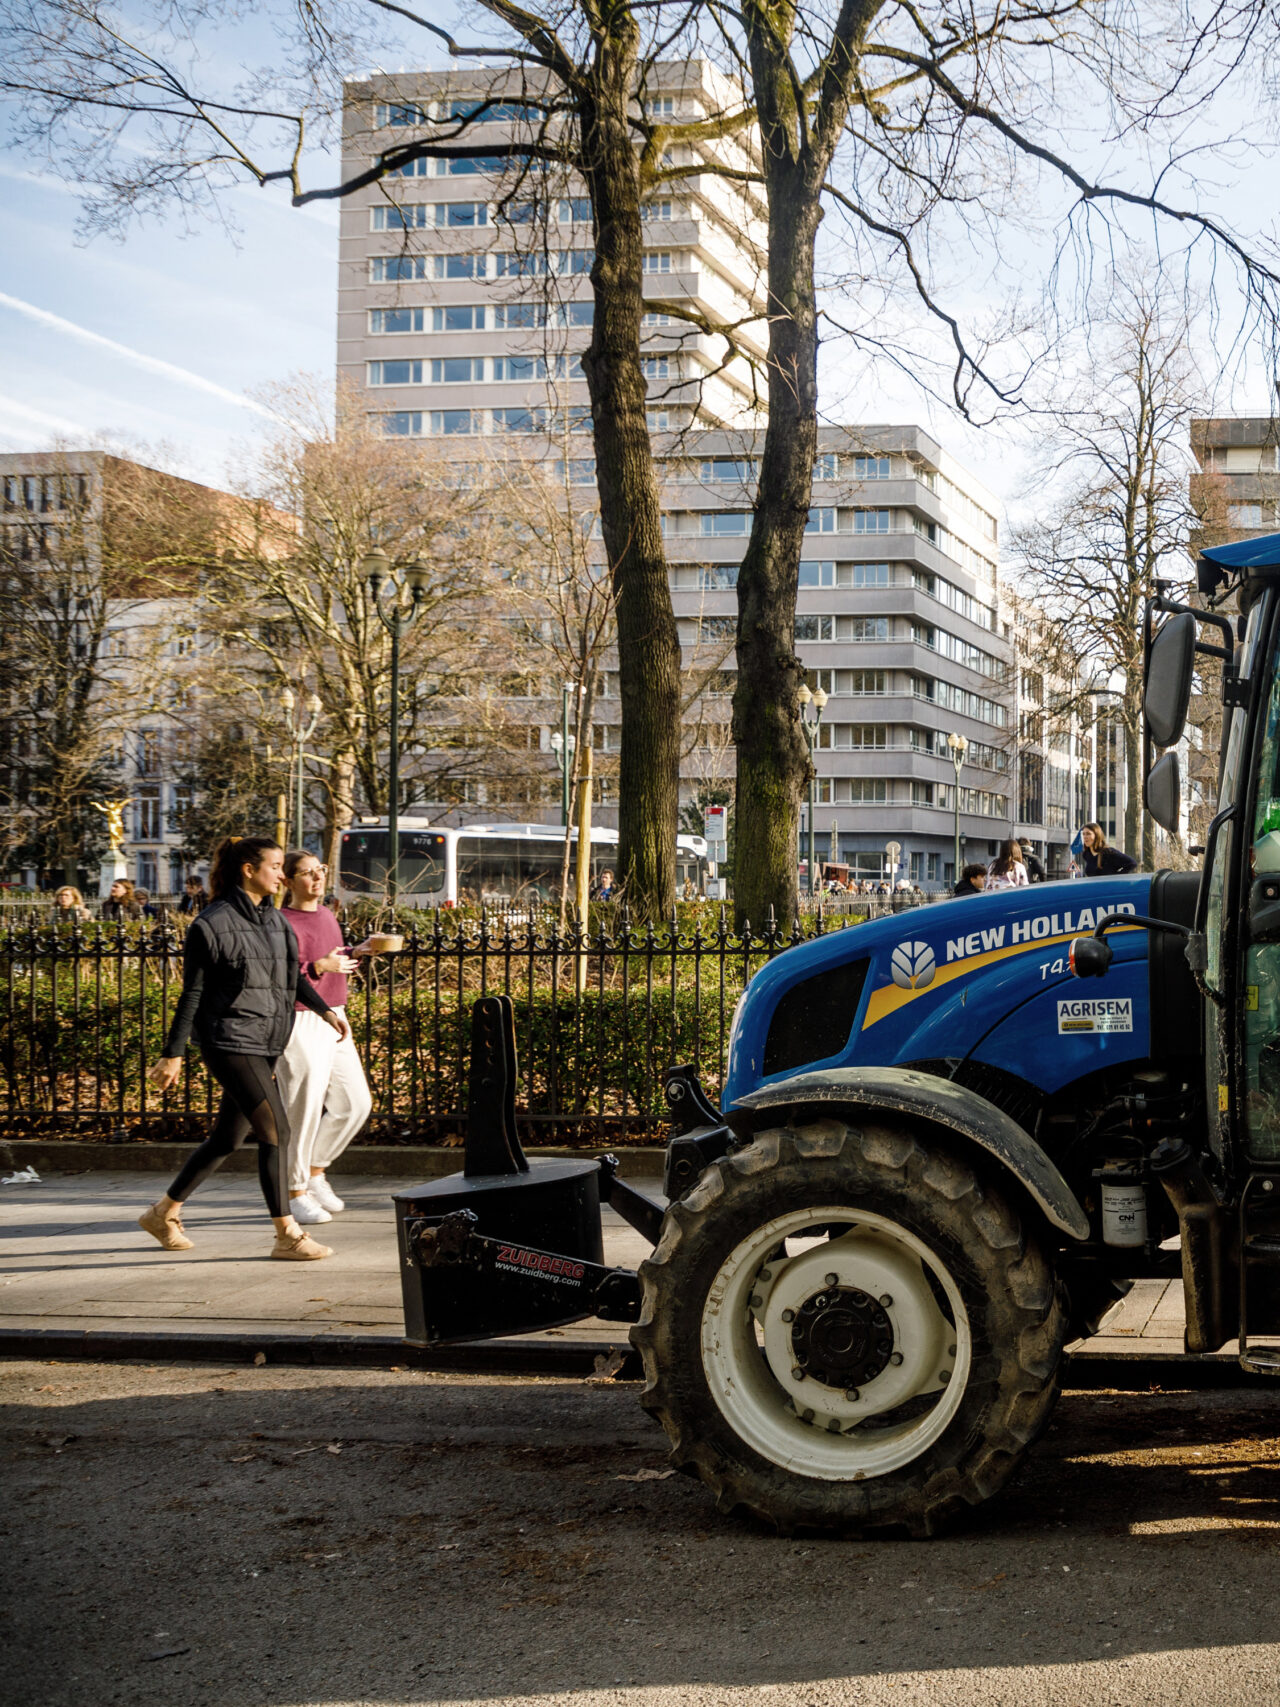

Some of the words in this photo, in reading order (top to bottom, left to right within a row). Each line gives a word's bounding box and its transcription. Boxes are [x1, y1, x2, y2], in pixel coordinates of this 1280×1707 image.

[946, 926, 1006, 961] NEW
[1012, 903, 1136, 944] HOLLAND
[1060, 1001, 1129, 1017] AGRISEM
[494, 1261, 581, 1287] www.zuidberg.com
[497, 1245, 585, 1279] ZUIDBERG
